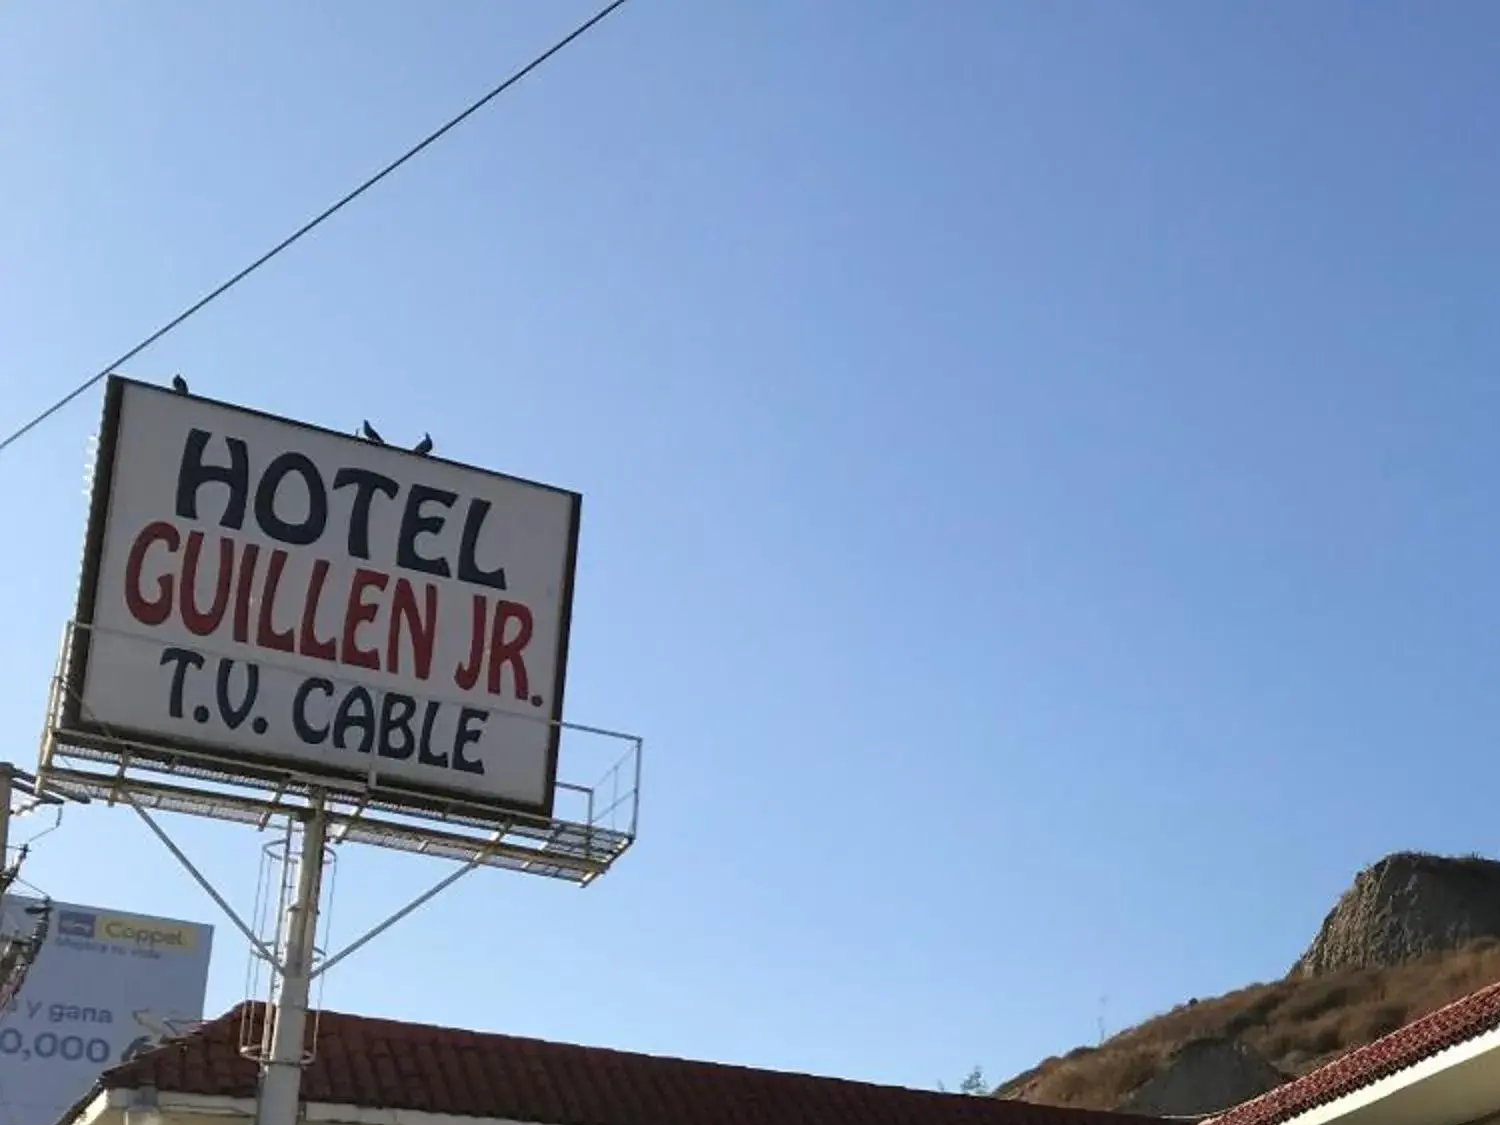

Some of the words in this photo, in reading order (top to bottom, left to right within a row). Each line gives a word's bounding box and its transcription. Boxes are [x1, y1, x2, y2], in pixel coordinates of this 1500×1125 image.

[174, 427, 507, 590] HOTEL
[124, 520, 439, 682] GUILLEN
[454, 595, 544, 708] JR.
[291, 677, 490, 775] CABLE
[104, 920, 185, 947] Coppel
[49, 1003, 113, 1024] gana
